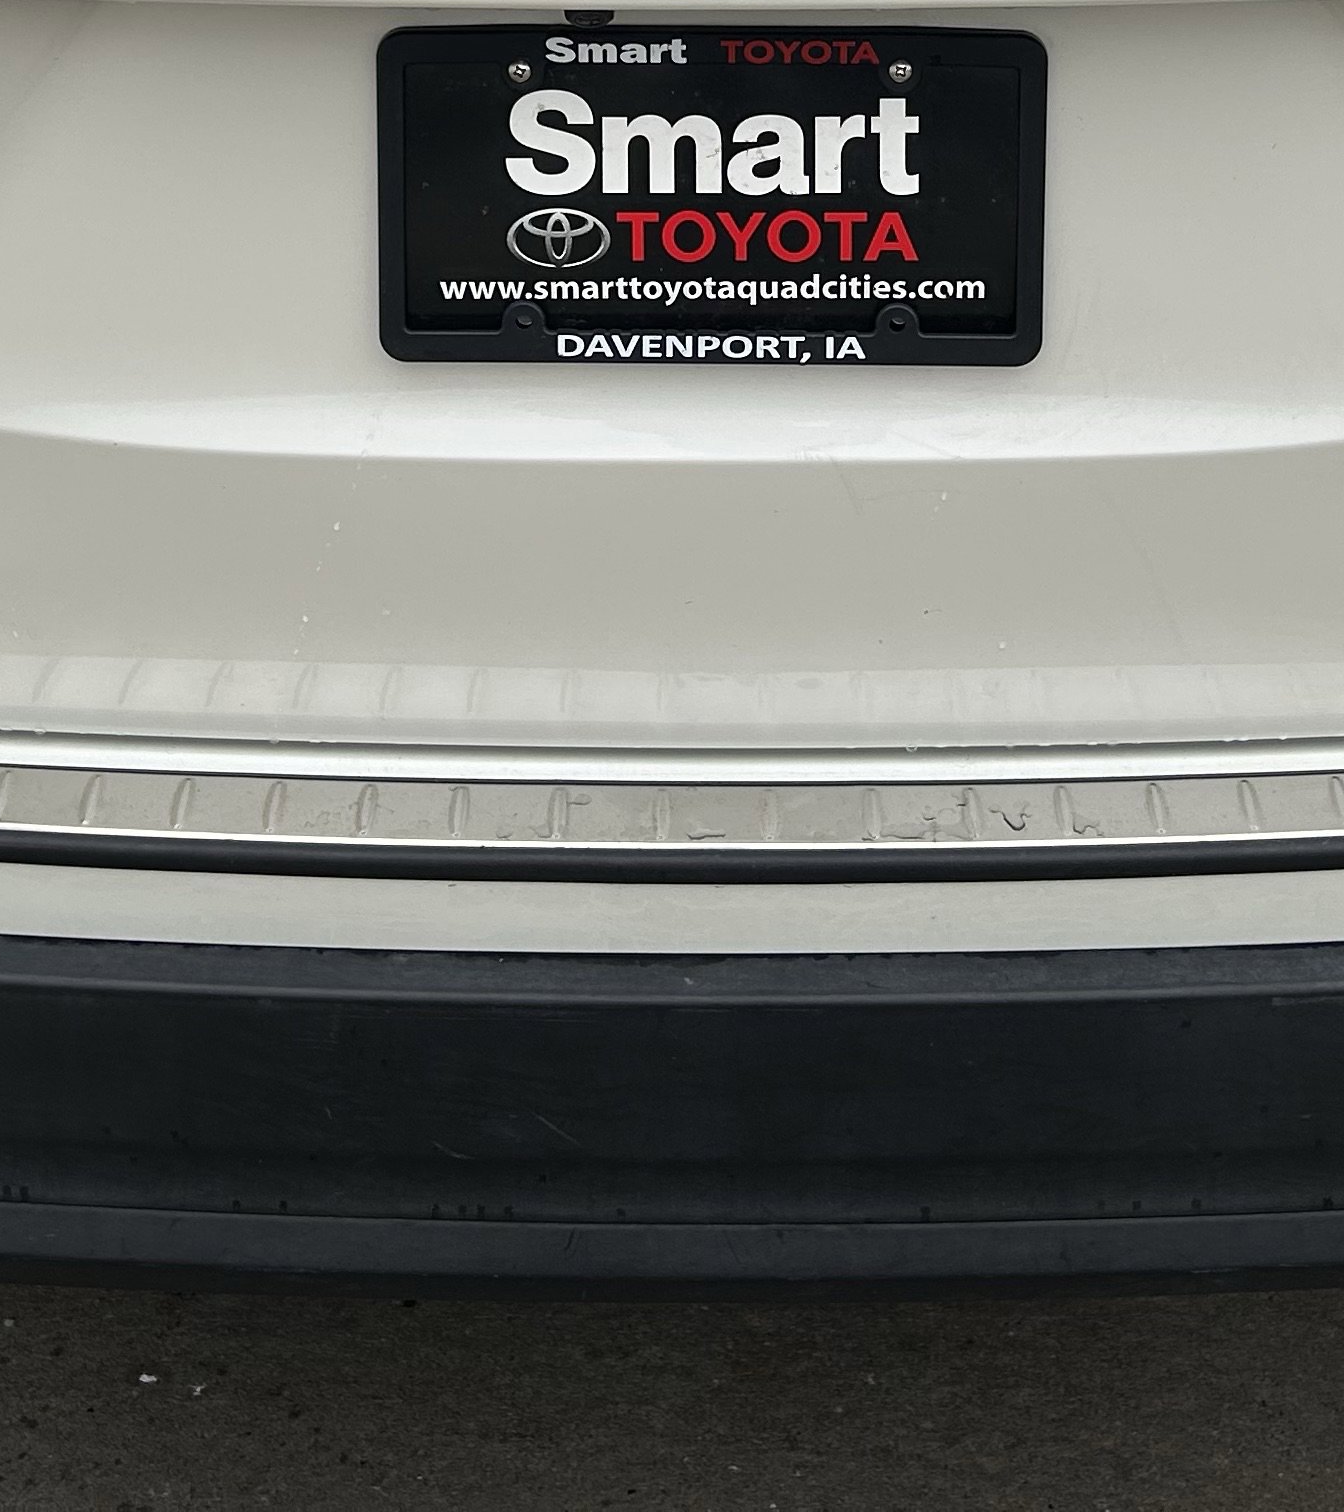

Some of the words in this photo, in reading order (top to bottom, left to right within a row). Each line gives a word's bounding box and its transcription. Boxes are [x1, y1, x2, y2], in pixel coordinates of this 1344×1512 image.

[545, 37, 688, 65] Smart
[720, 39, 880, 65] TOYOTA
[505, 89, 920, 196] Smart
[616, 209, 919, 263] TOYOTA
[440, 274, 986, 306] www.smarttoyotaquadcities.com
[557, 334, 811, 363] DAVENPORT,
[824, 335, 866, 360] IA
